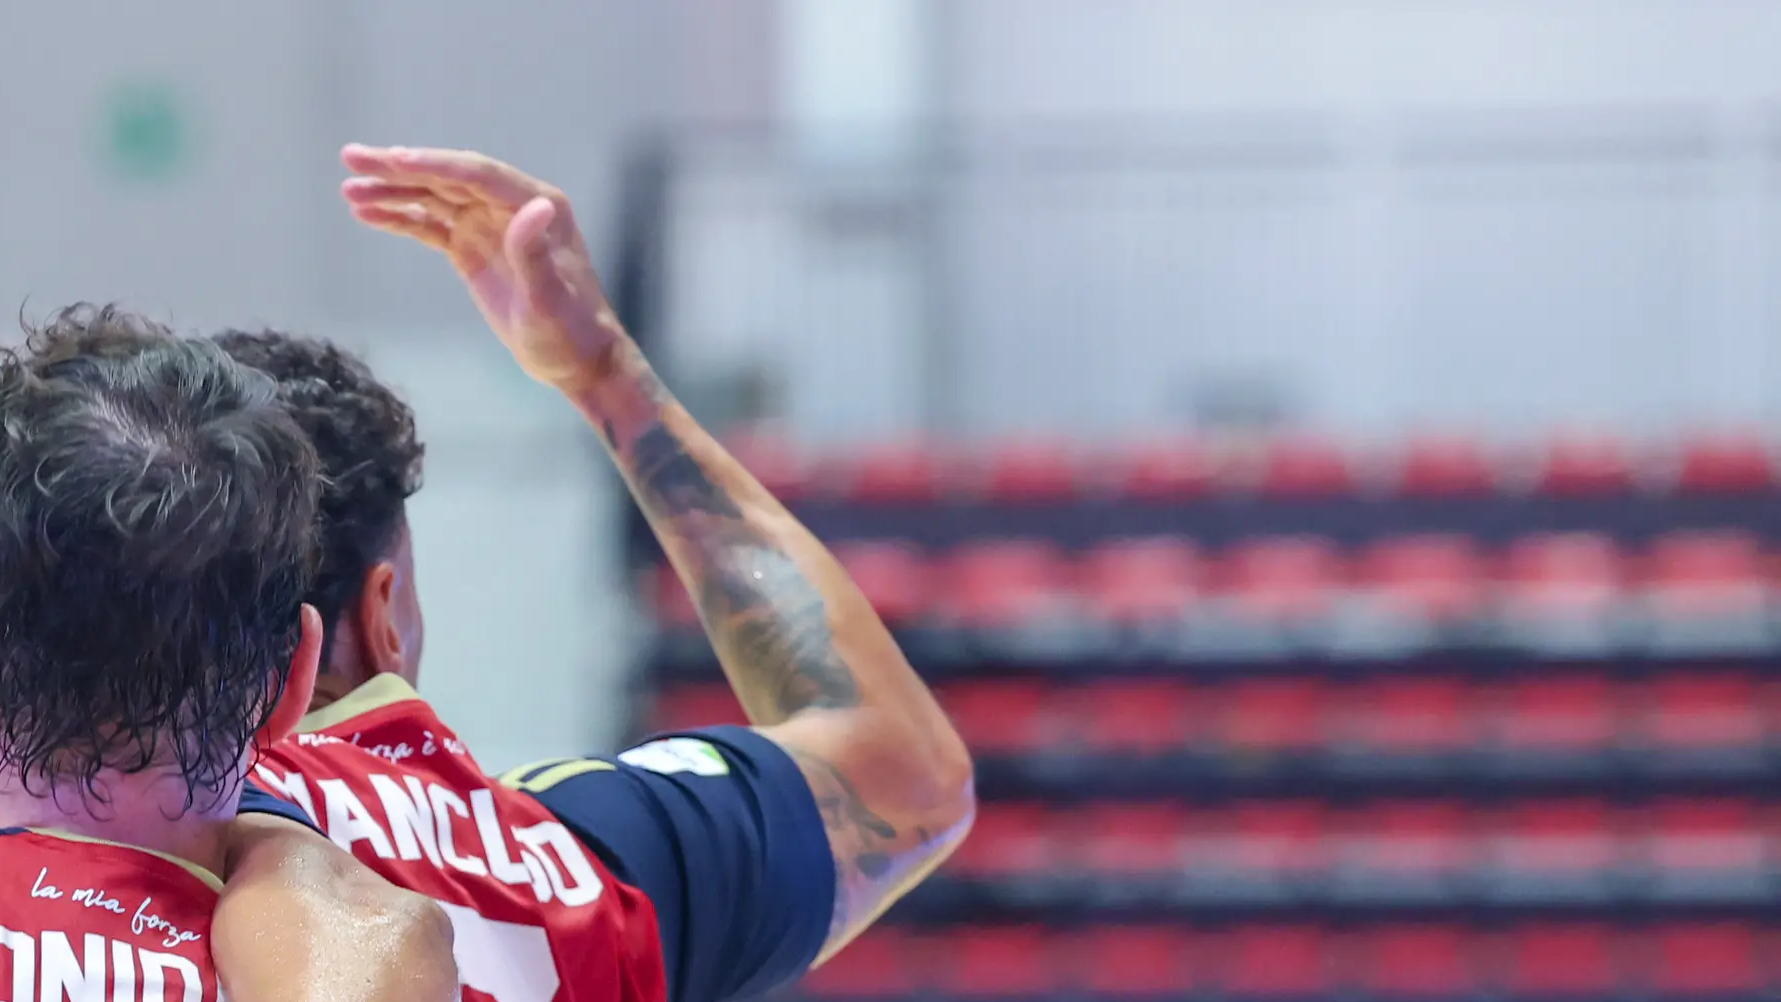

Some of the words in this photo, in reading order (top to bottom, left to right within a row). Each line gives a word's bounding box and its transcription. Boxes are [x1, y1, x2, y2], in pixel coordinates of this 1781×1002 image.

[31, 867, 63, 898] la
[72, 887, 125, 914] mia
[131, 896, 201, 948] forza
